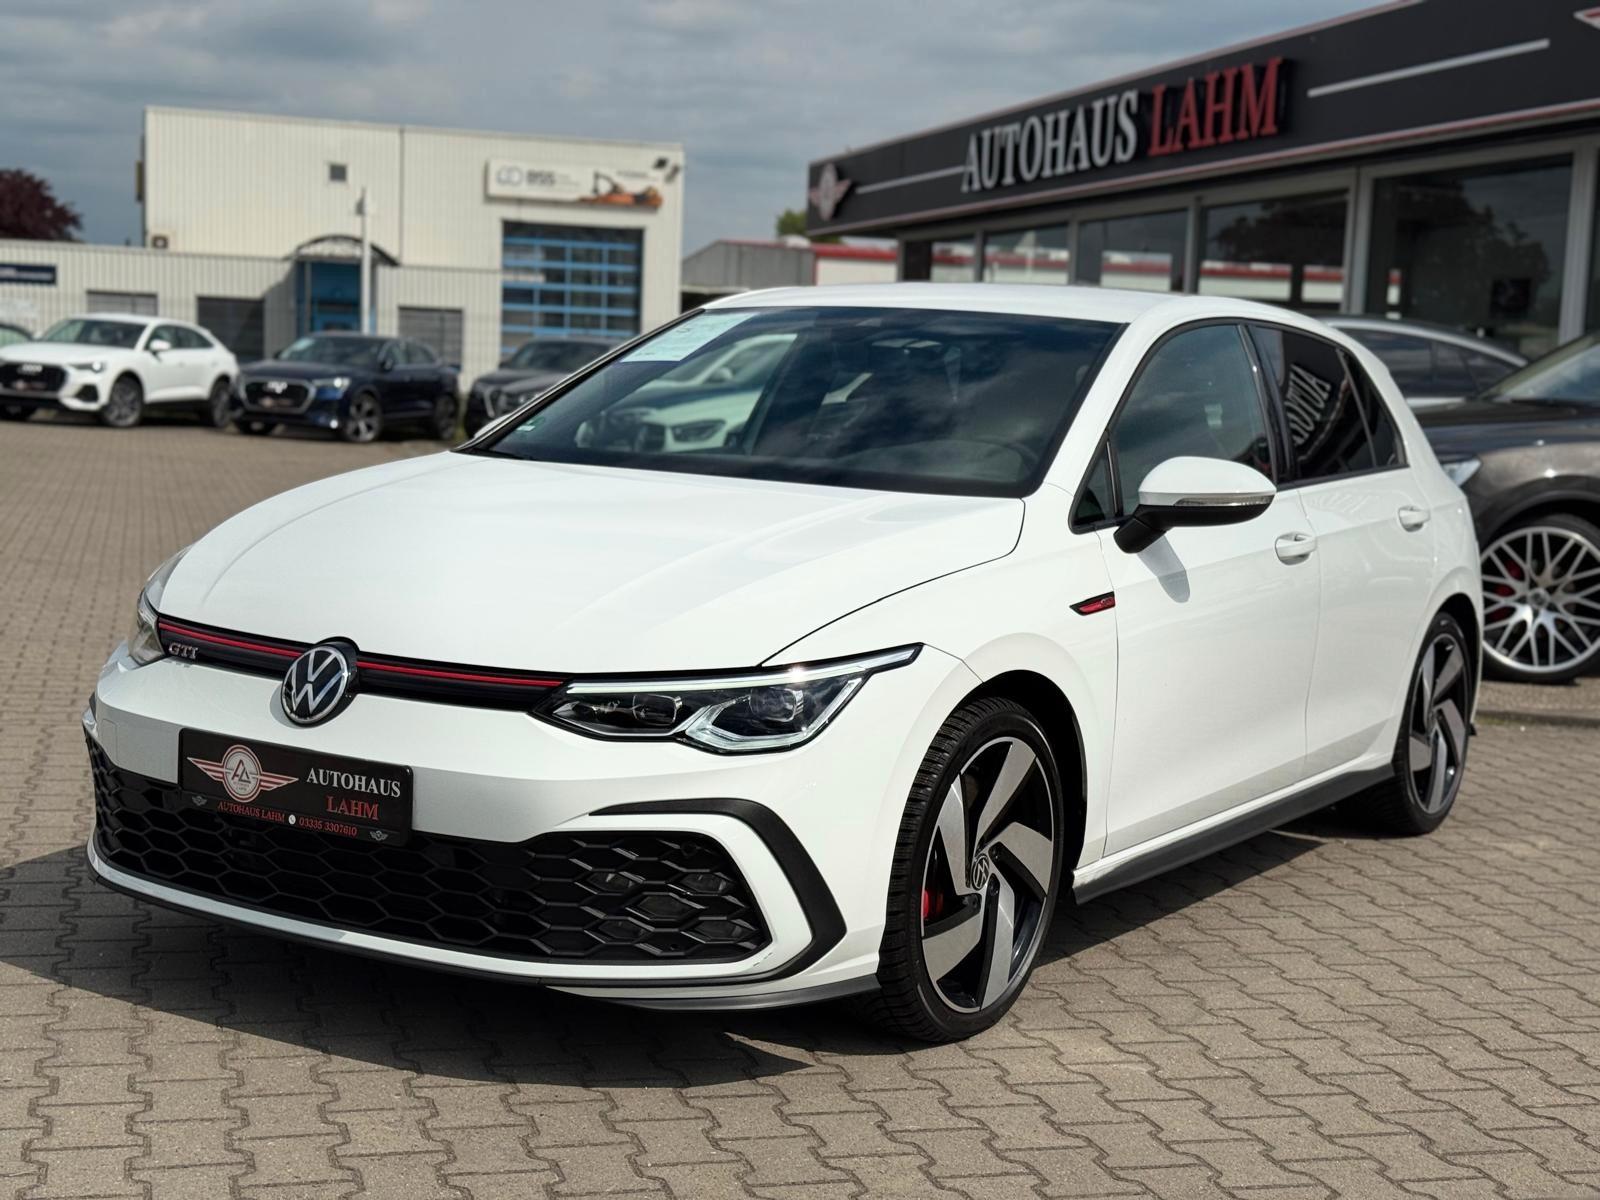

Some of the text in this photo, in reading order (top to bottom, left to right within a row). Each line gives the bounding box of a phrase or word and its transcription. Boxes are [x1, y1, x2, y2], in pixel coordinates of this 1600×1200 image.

[961, 56, 1283, 193] AUTOHAUS LAHM
[168, 642, 199, 660] GTI
[306, 767, 401, 798] AUTOHAUS
[217, 801, 260, 818] AUTOHAUS
[261, 809, 286, 823] LAHM
[299, 817, 323, 830] 03335
[326, 795, 379, 821] LAHM
